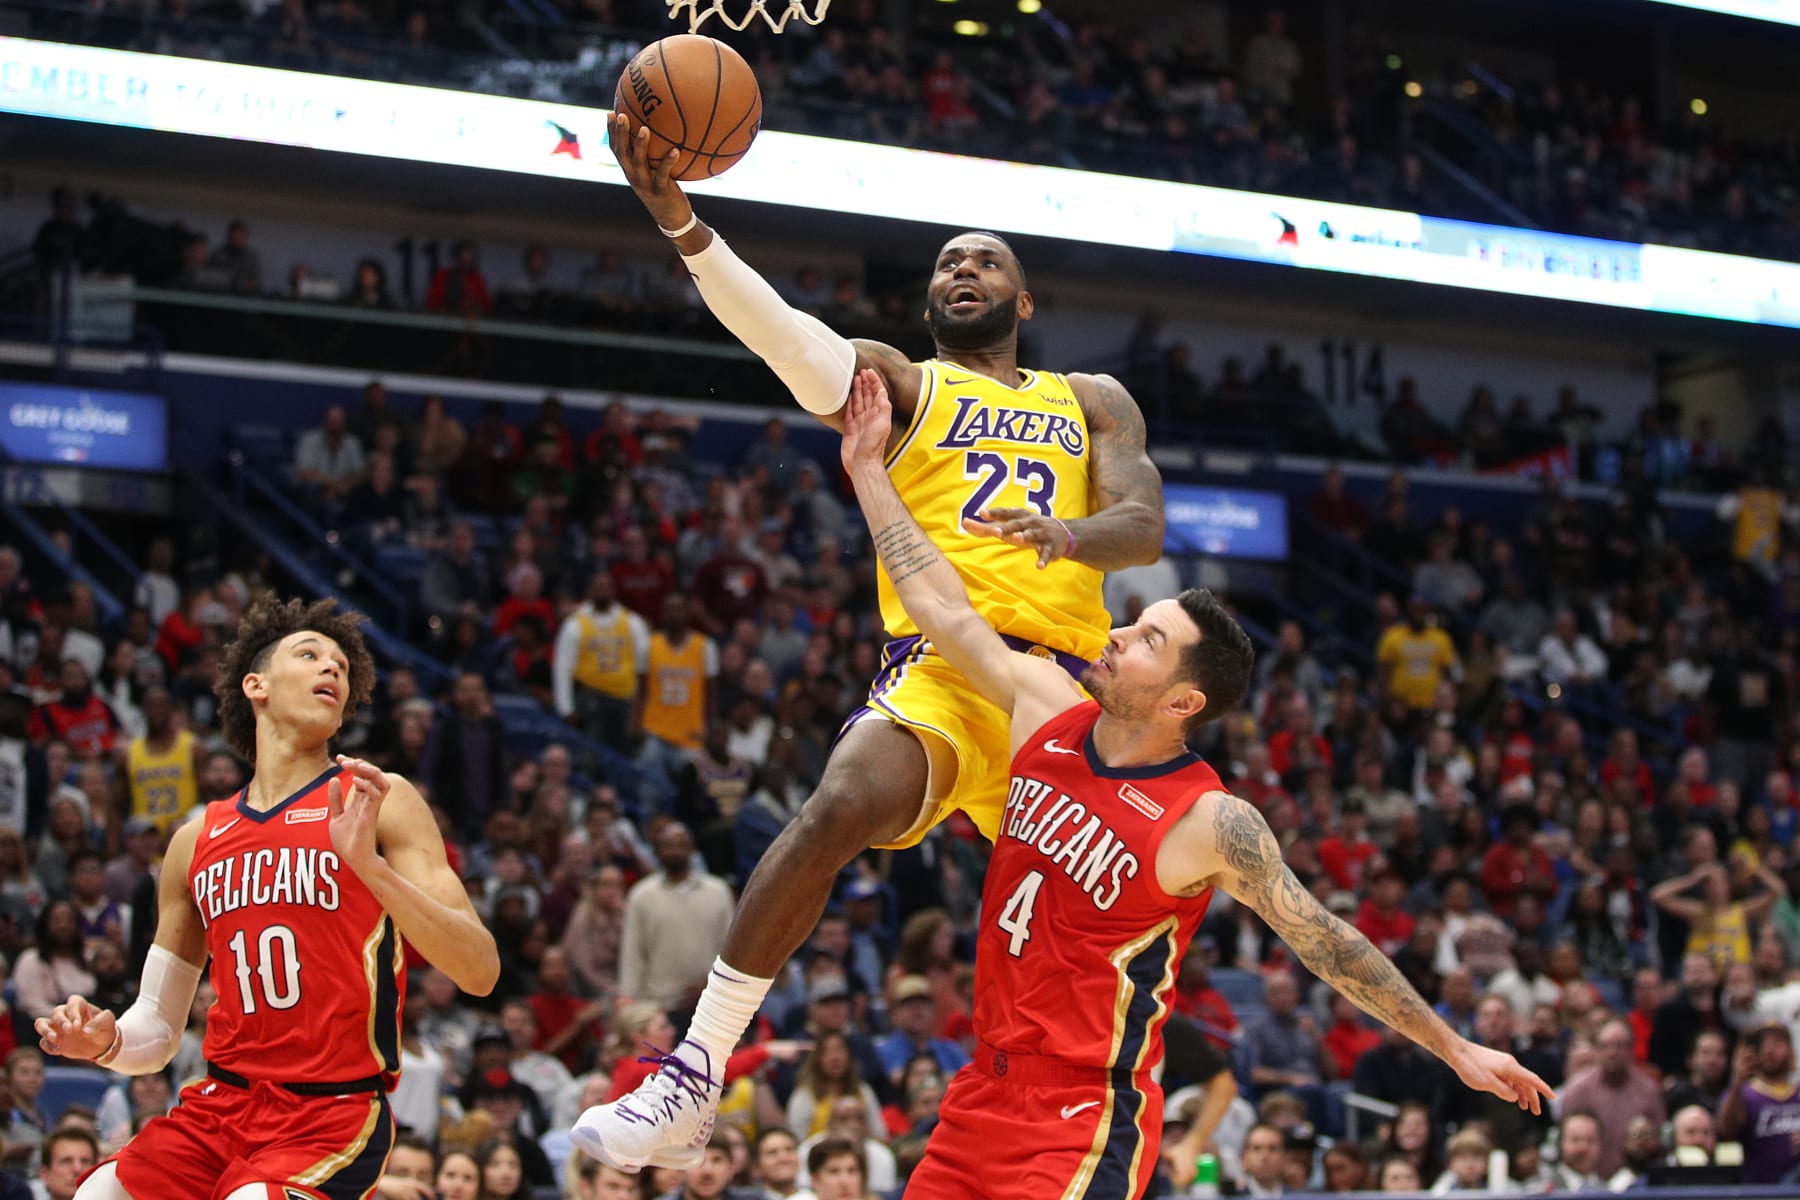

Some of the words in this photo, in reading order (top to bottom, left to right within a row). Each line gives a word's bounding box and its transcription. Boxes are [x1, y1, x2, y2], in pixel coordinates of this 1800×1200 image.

[936, 397, 1084, 457] LAKERS
[1038, 393, 1073, 406] wish
[960, 450, 1057, 528] 23
[1000, 776, 1139, 911] PELICANS
[193, 846, 340, 930] PELICANS
[997, 869, 1045, 957] 4
[228, 924, 302, 1014] 10
